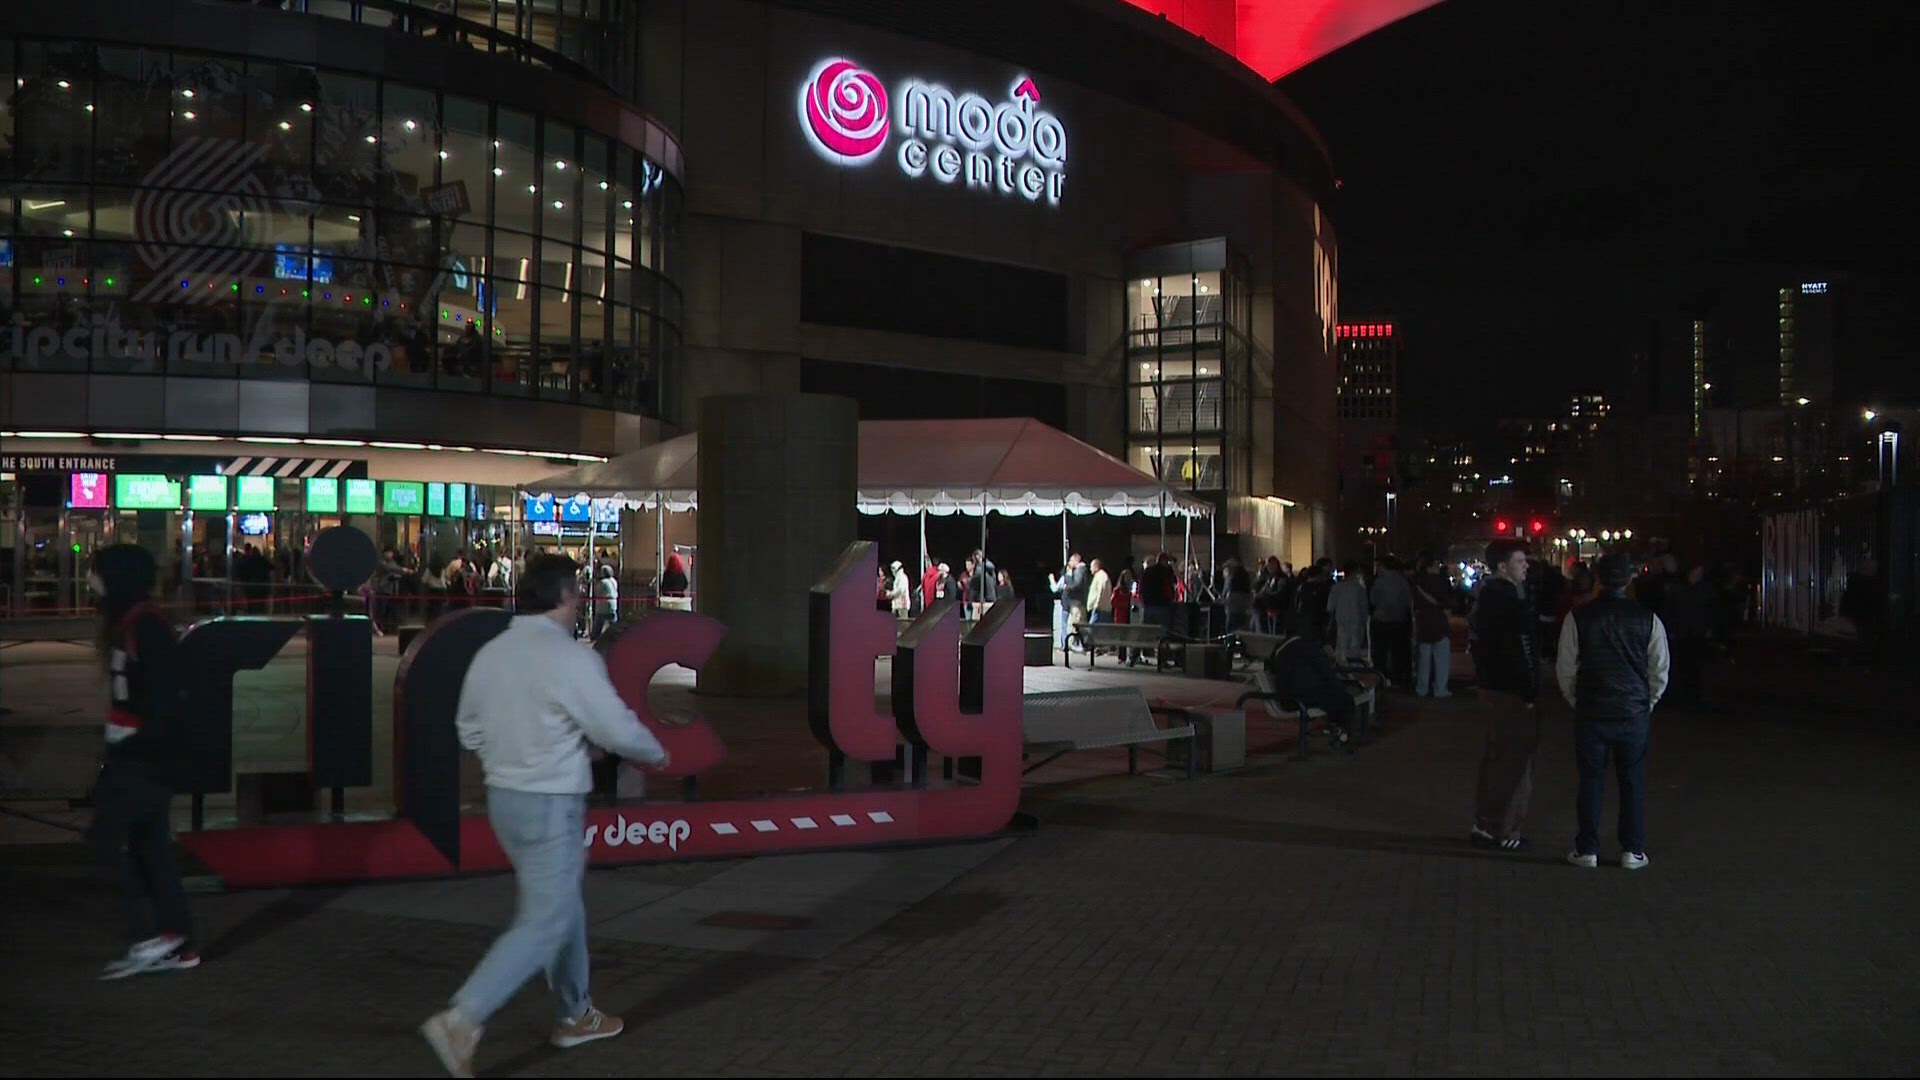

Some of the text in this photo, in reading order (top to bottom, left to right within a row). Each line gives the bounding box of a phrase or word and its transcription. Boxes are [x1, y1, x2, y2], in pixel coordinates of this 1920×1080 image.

[905, 77, 1067, 162] moda
[904, 140, 1067, 199] center
[1801, 282, 1828, 290] HYATT
[273, 324, 393, 383] deep
[2, 457, 116, 471] HE SOUTH ENTRANCE
[603, 813, 691, 853] deep
